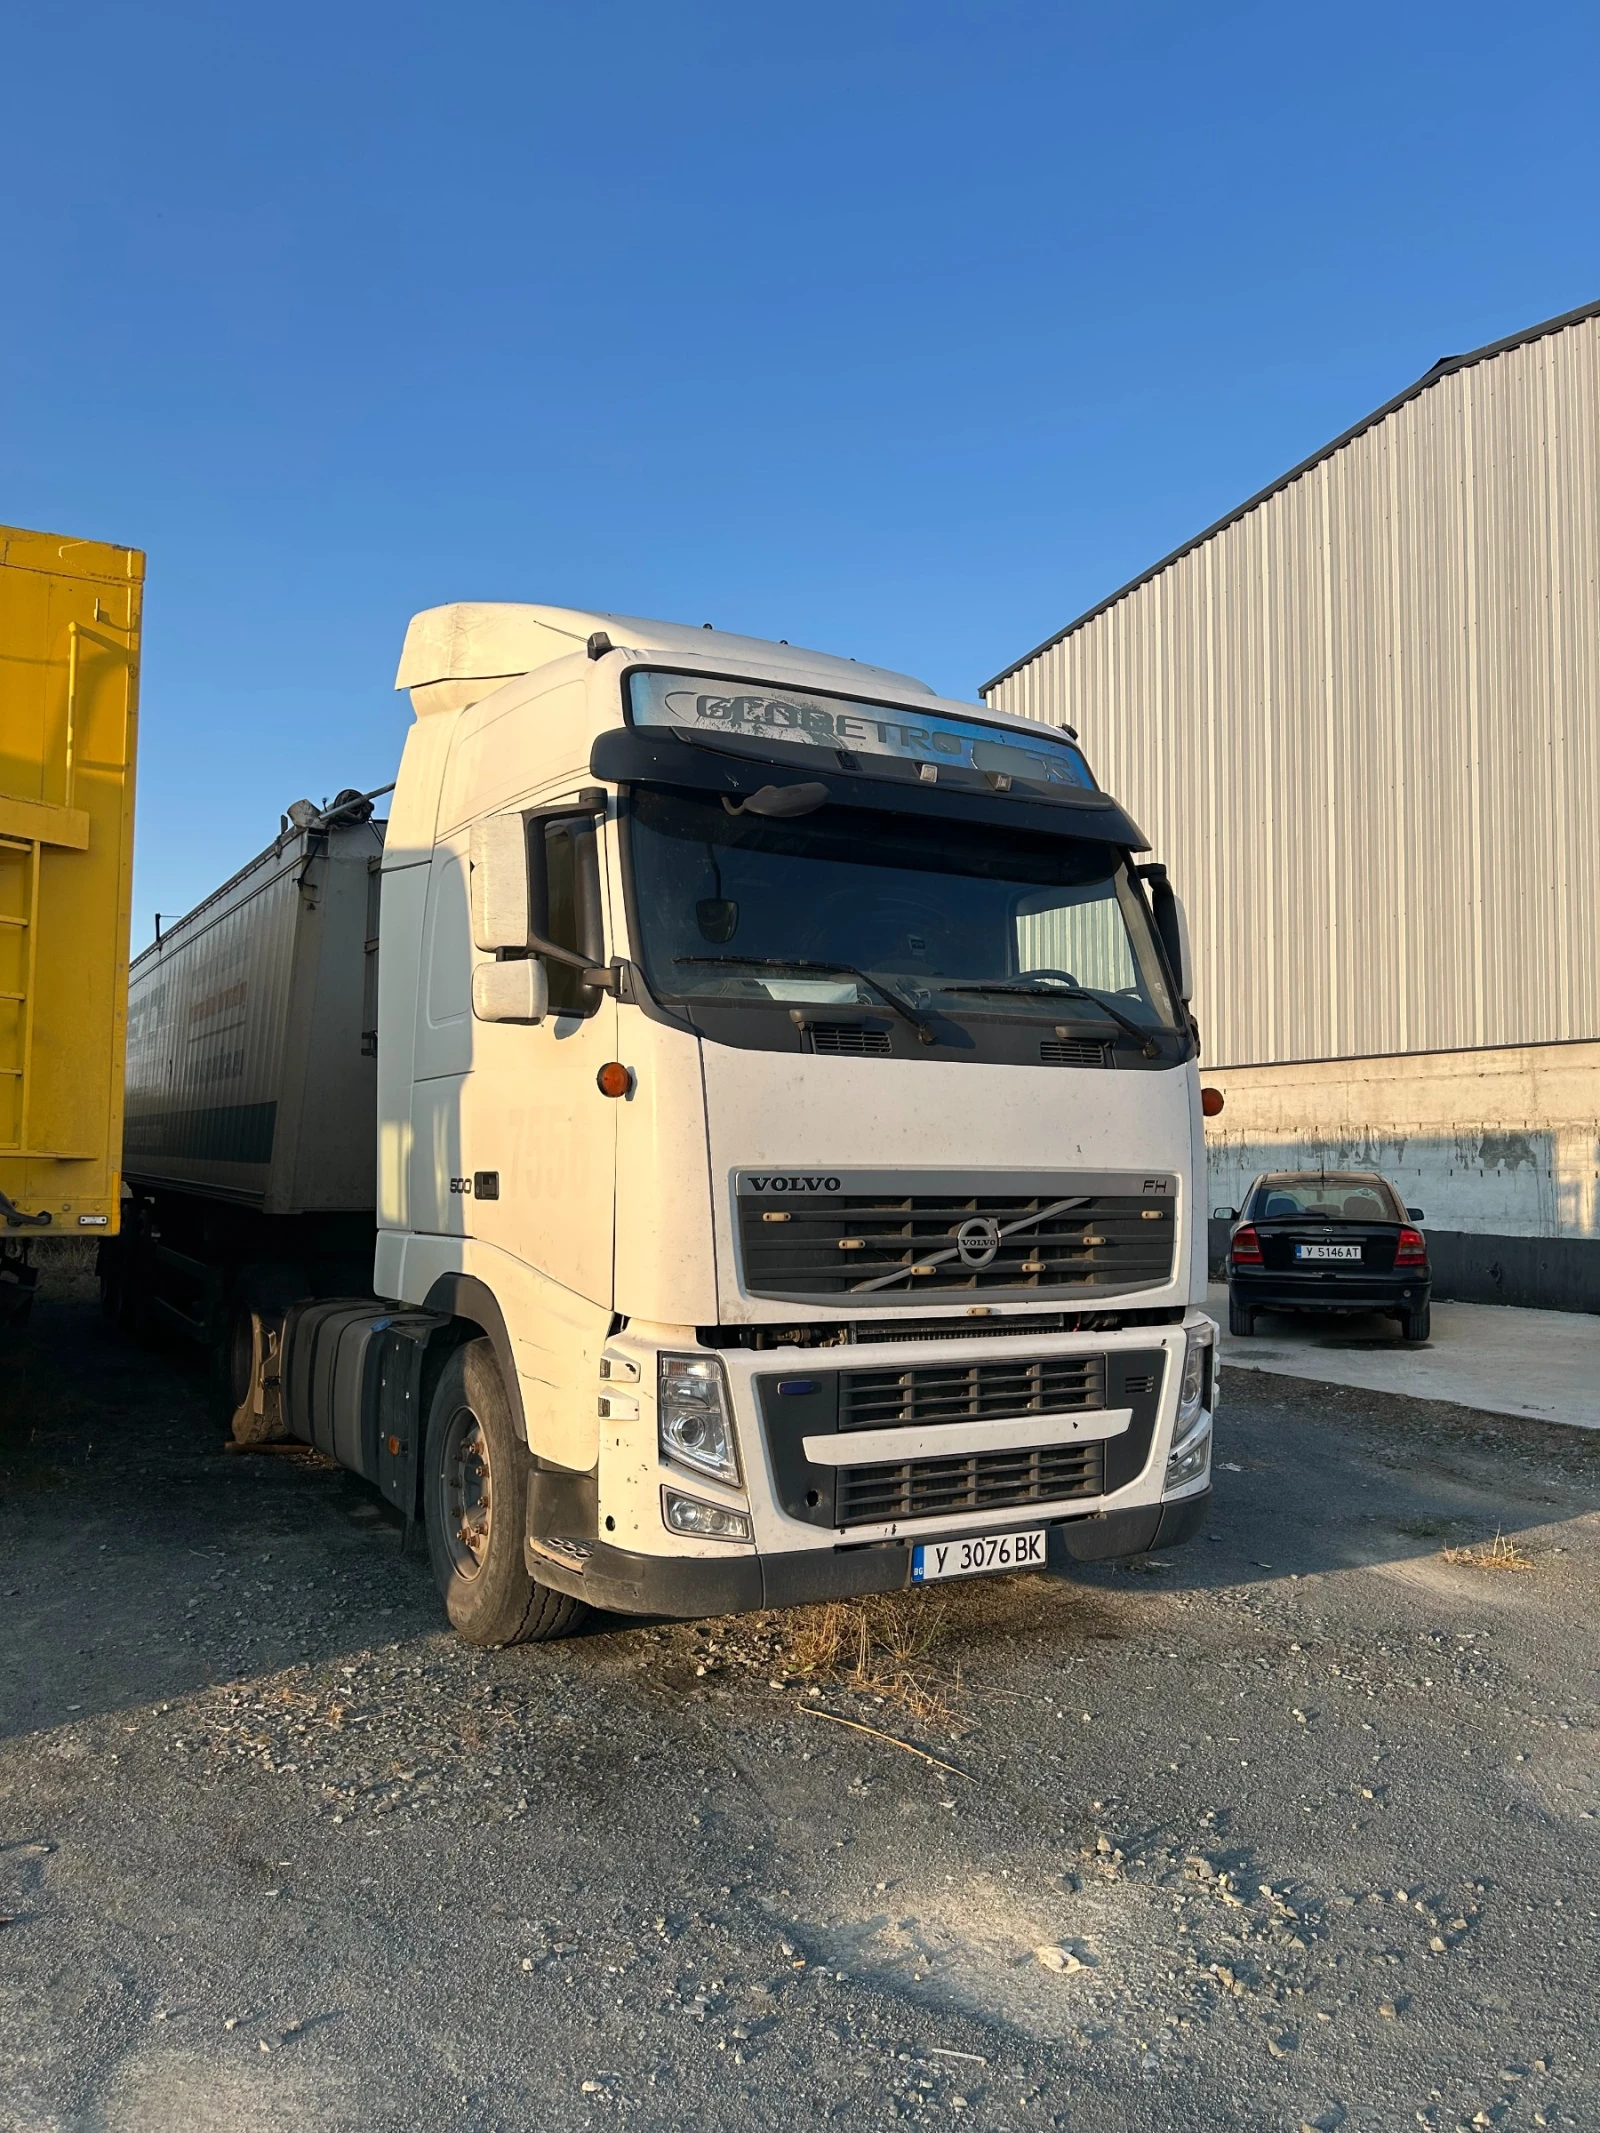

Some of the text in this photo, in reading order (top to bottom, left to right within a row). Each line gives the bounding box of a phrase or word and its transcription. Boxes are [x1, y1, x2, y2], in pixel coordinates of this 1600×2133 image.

[450, 1178, 472, 1194] 500
[747, 1177, 841, 1191] VOLVO
[1142, 1180, 1167, 1193] FH
[1318, 1247, 1344, 1258] 5146
[960, 1538, 1011, 1569] 3076
[913, 1567, 924, 1576] BG
